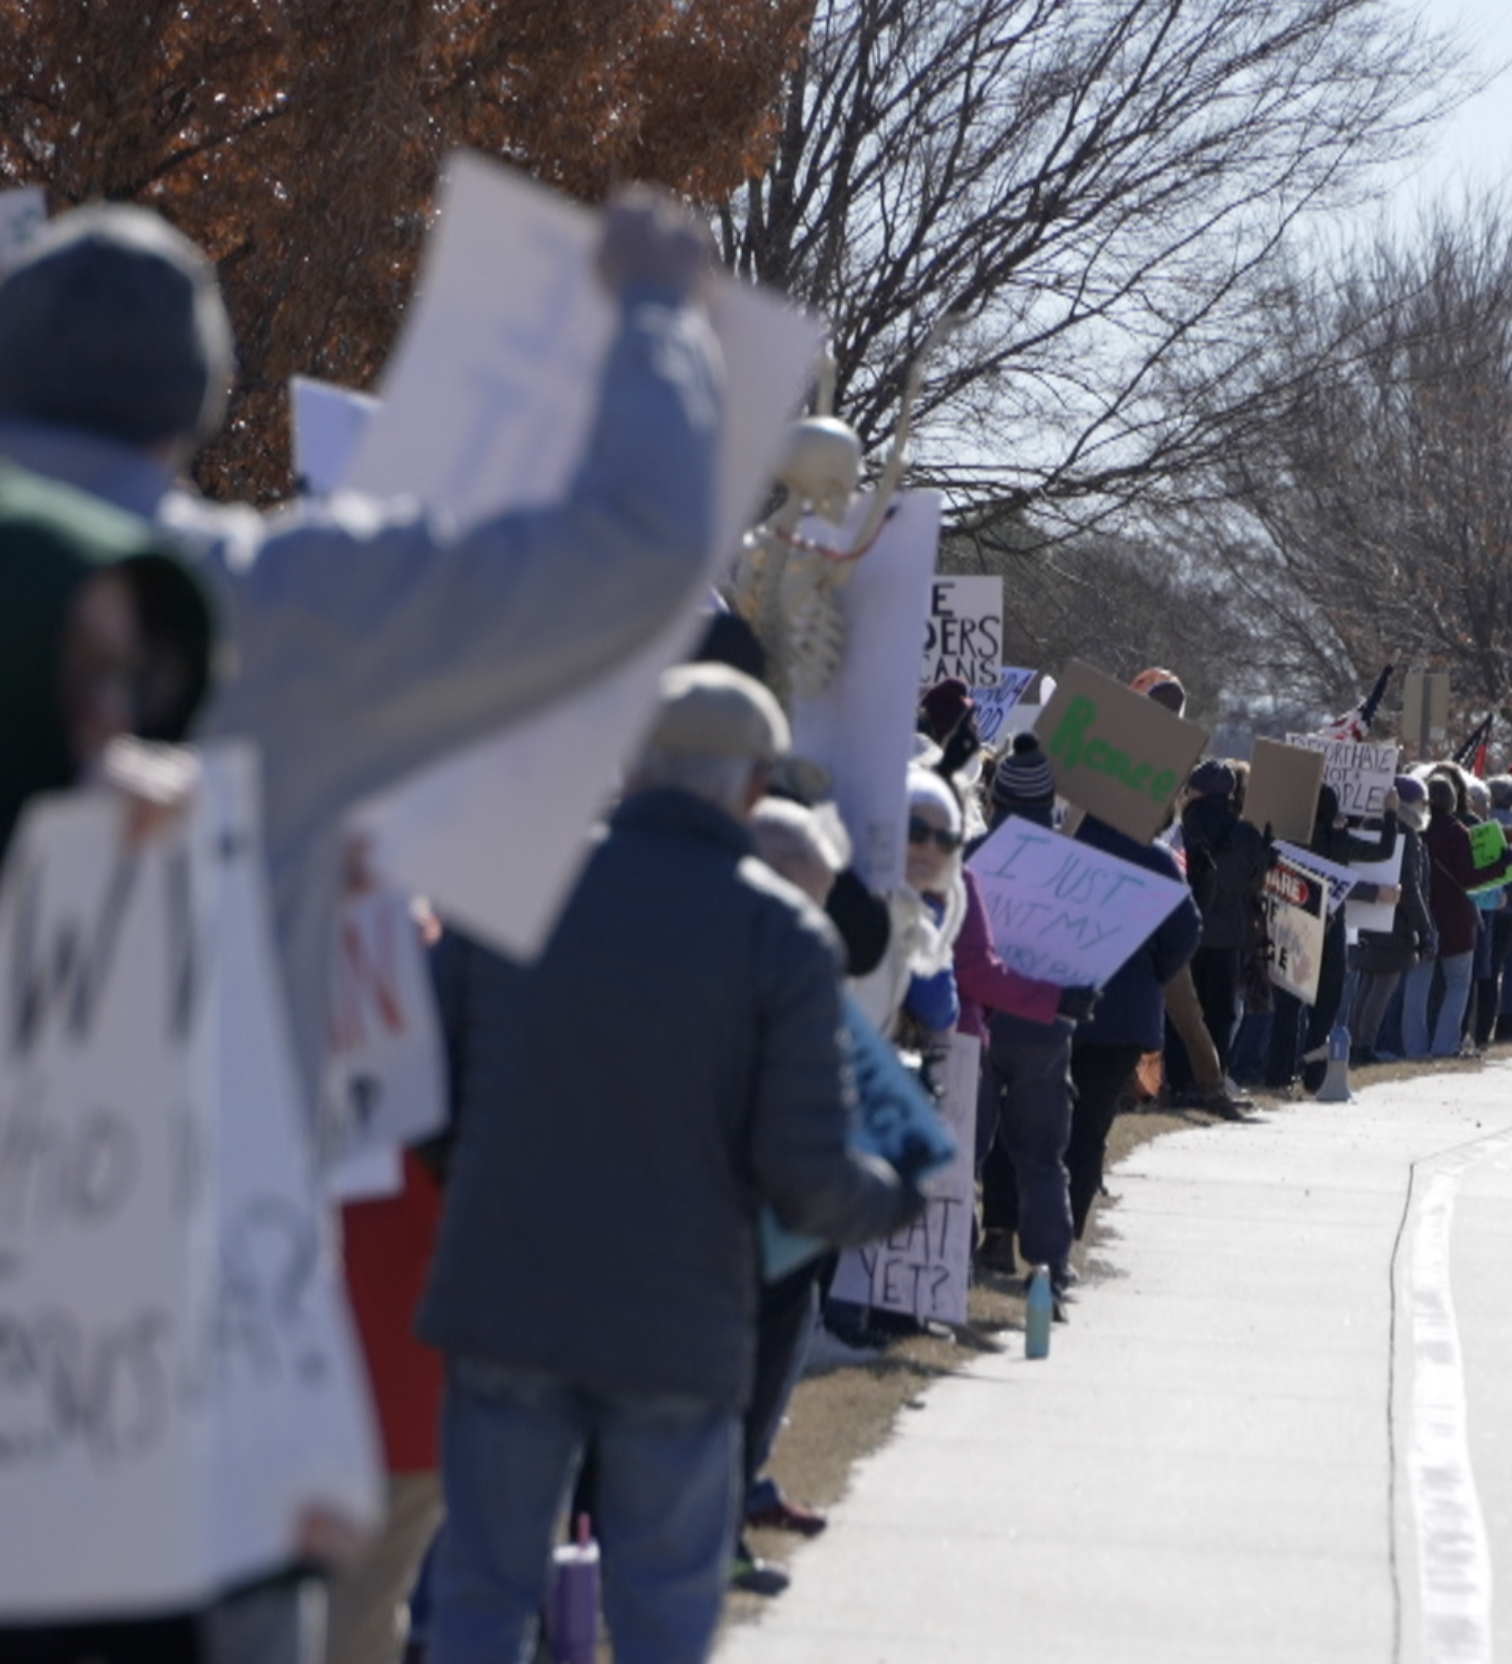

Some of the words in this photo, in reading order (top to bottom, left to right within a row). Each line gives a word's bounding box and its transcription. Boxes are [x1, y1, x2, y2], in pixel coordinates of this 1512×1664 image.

[984, 833, 1052, 880] I
[1036, 851, 1146, 906] JUST
[1035, 910, 1123, 951] MY
[859, 1249, 950, 1313] YET?
